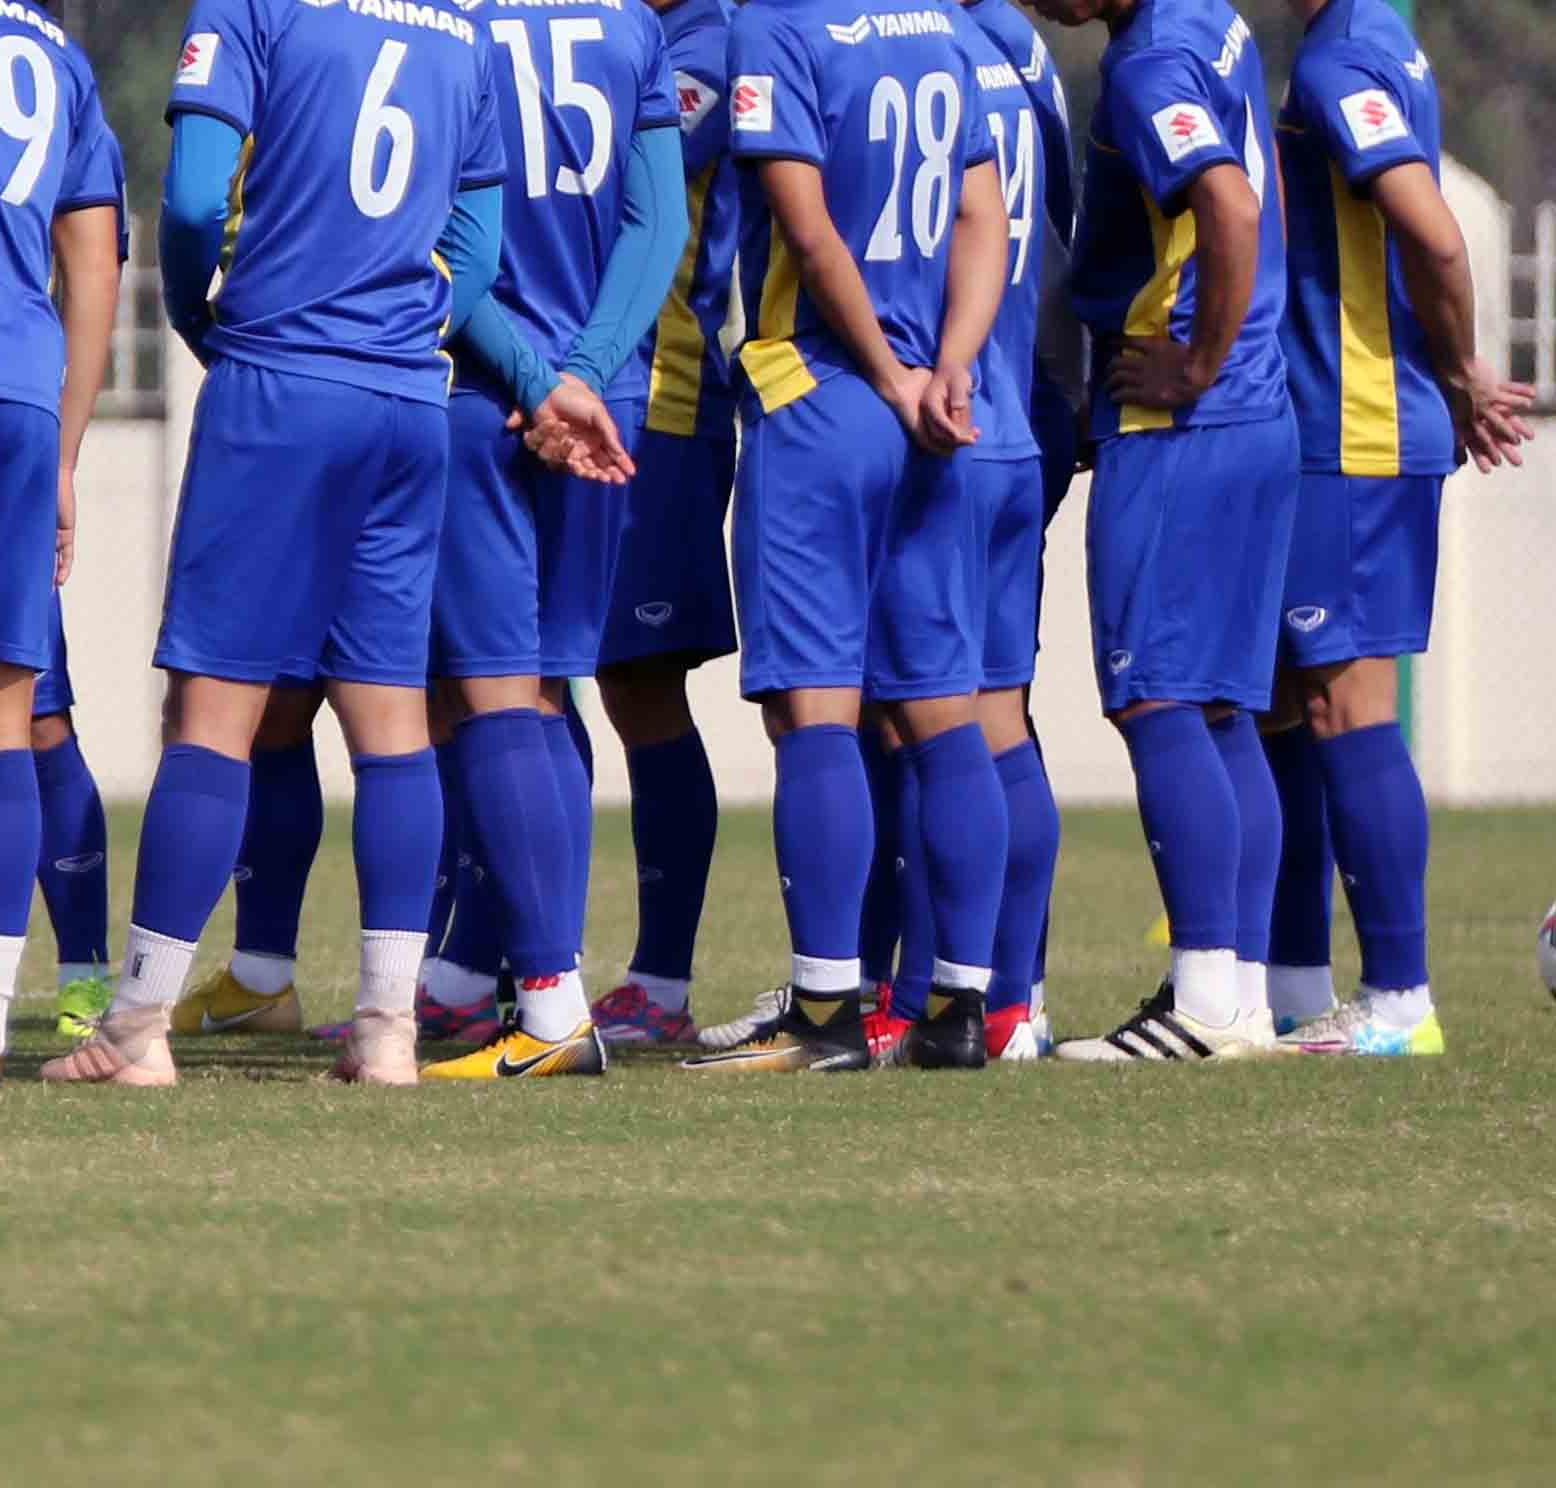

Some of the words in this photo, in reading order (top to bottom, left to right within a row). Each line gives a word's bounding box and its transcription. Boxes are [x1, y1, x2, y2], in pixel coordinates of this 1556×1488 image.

[489, 17, 612, 199] 15
[871, 10, 954, 38] YANMA
[349, 38, 414, 219] 6
[863, 71, 961, 261] 28
[988, 109, 1035, 286] 14
